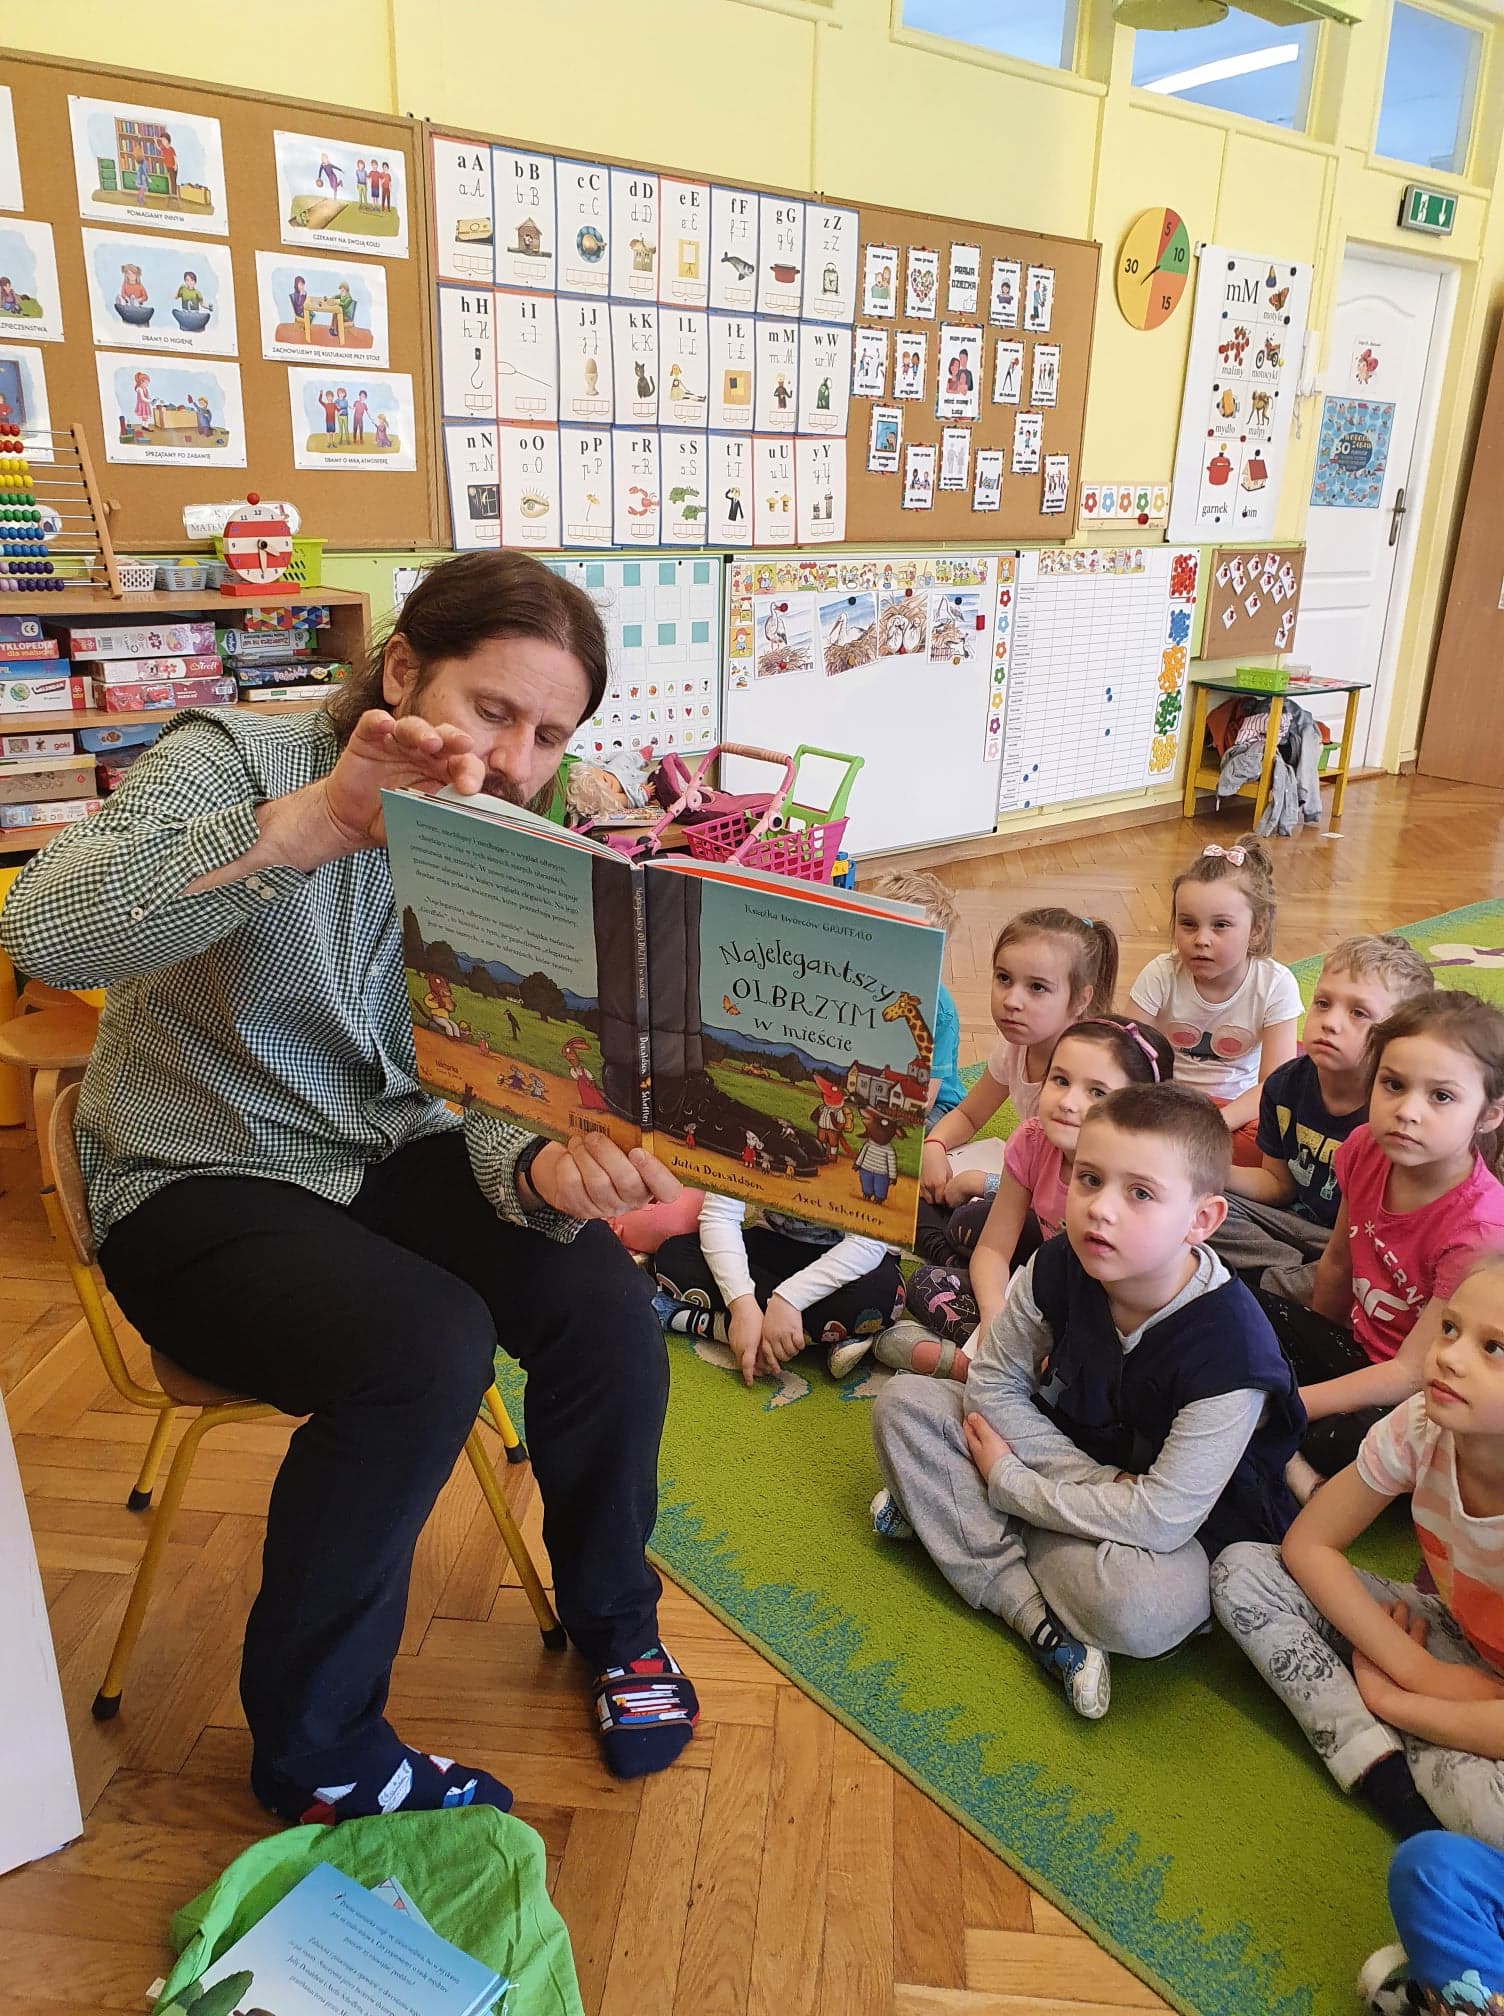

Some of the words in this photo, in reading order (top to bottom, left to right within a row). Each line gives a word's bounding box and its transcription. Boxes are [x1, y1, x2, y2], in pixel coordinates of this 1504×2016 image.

[1164, 221, 1172, 236] 5
[1124, 257, 1139, 274] 30
[1173, 247, 1185, 263] 10
[1161, 295, 1172, 310] 15
[1225, 278, 1261, 305] mM
[1221, 365, 1244, 378] maliny
[1201, 501, 1228, 518] garnek
[198, 661, 218, 671] Trefl
[719, 937, 896, 1002] Najelegantszy
[732, 977, 877, 1029] OLBRZYM
[753, 1017, 774, 1031] w
[782, 1024, 853, 1052] mieście
[639, 1036, 649, 1075] Donaldson
[641, 1090, 651, 1122] Scheffler
[671, 1155, 701, 1173] Julia
[702, 1164, 765, 1191] Donaldson
[792, 1191, 822, 1208] Axel
[827, 1201, 885, 1226] Scheffler
